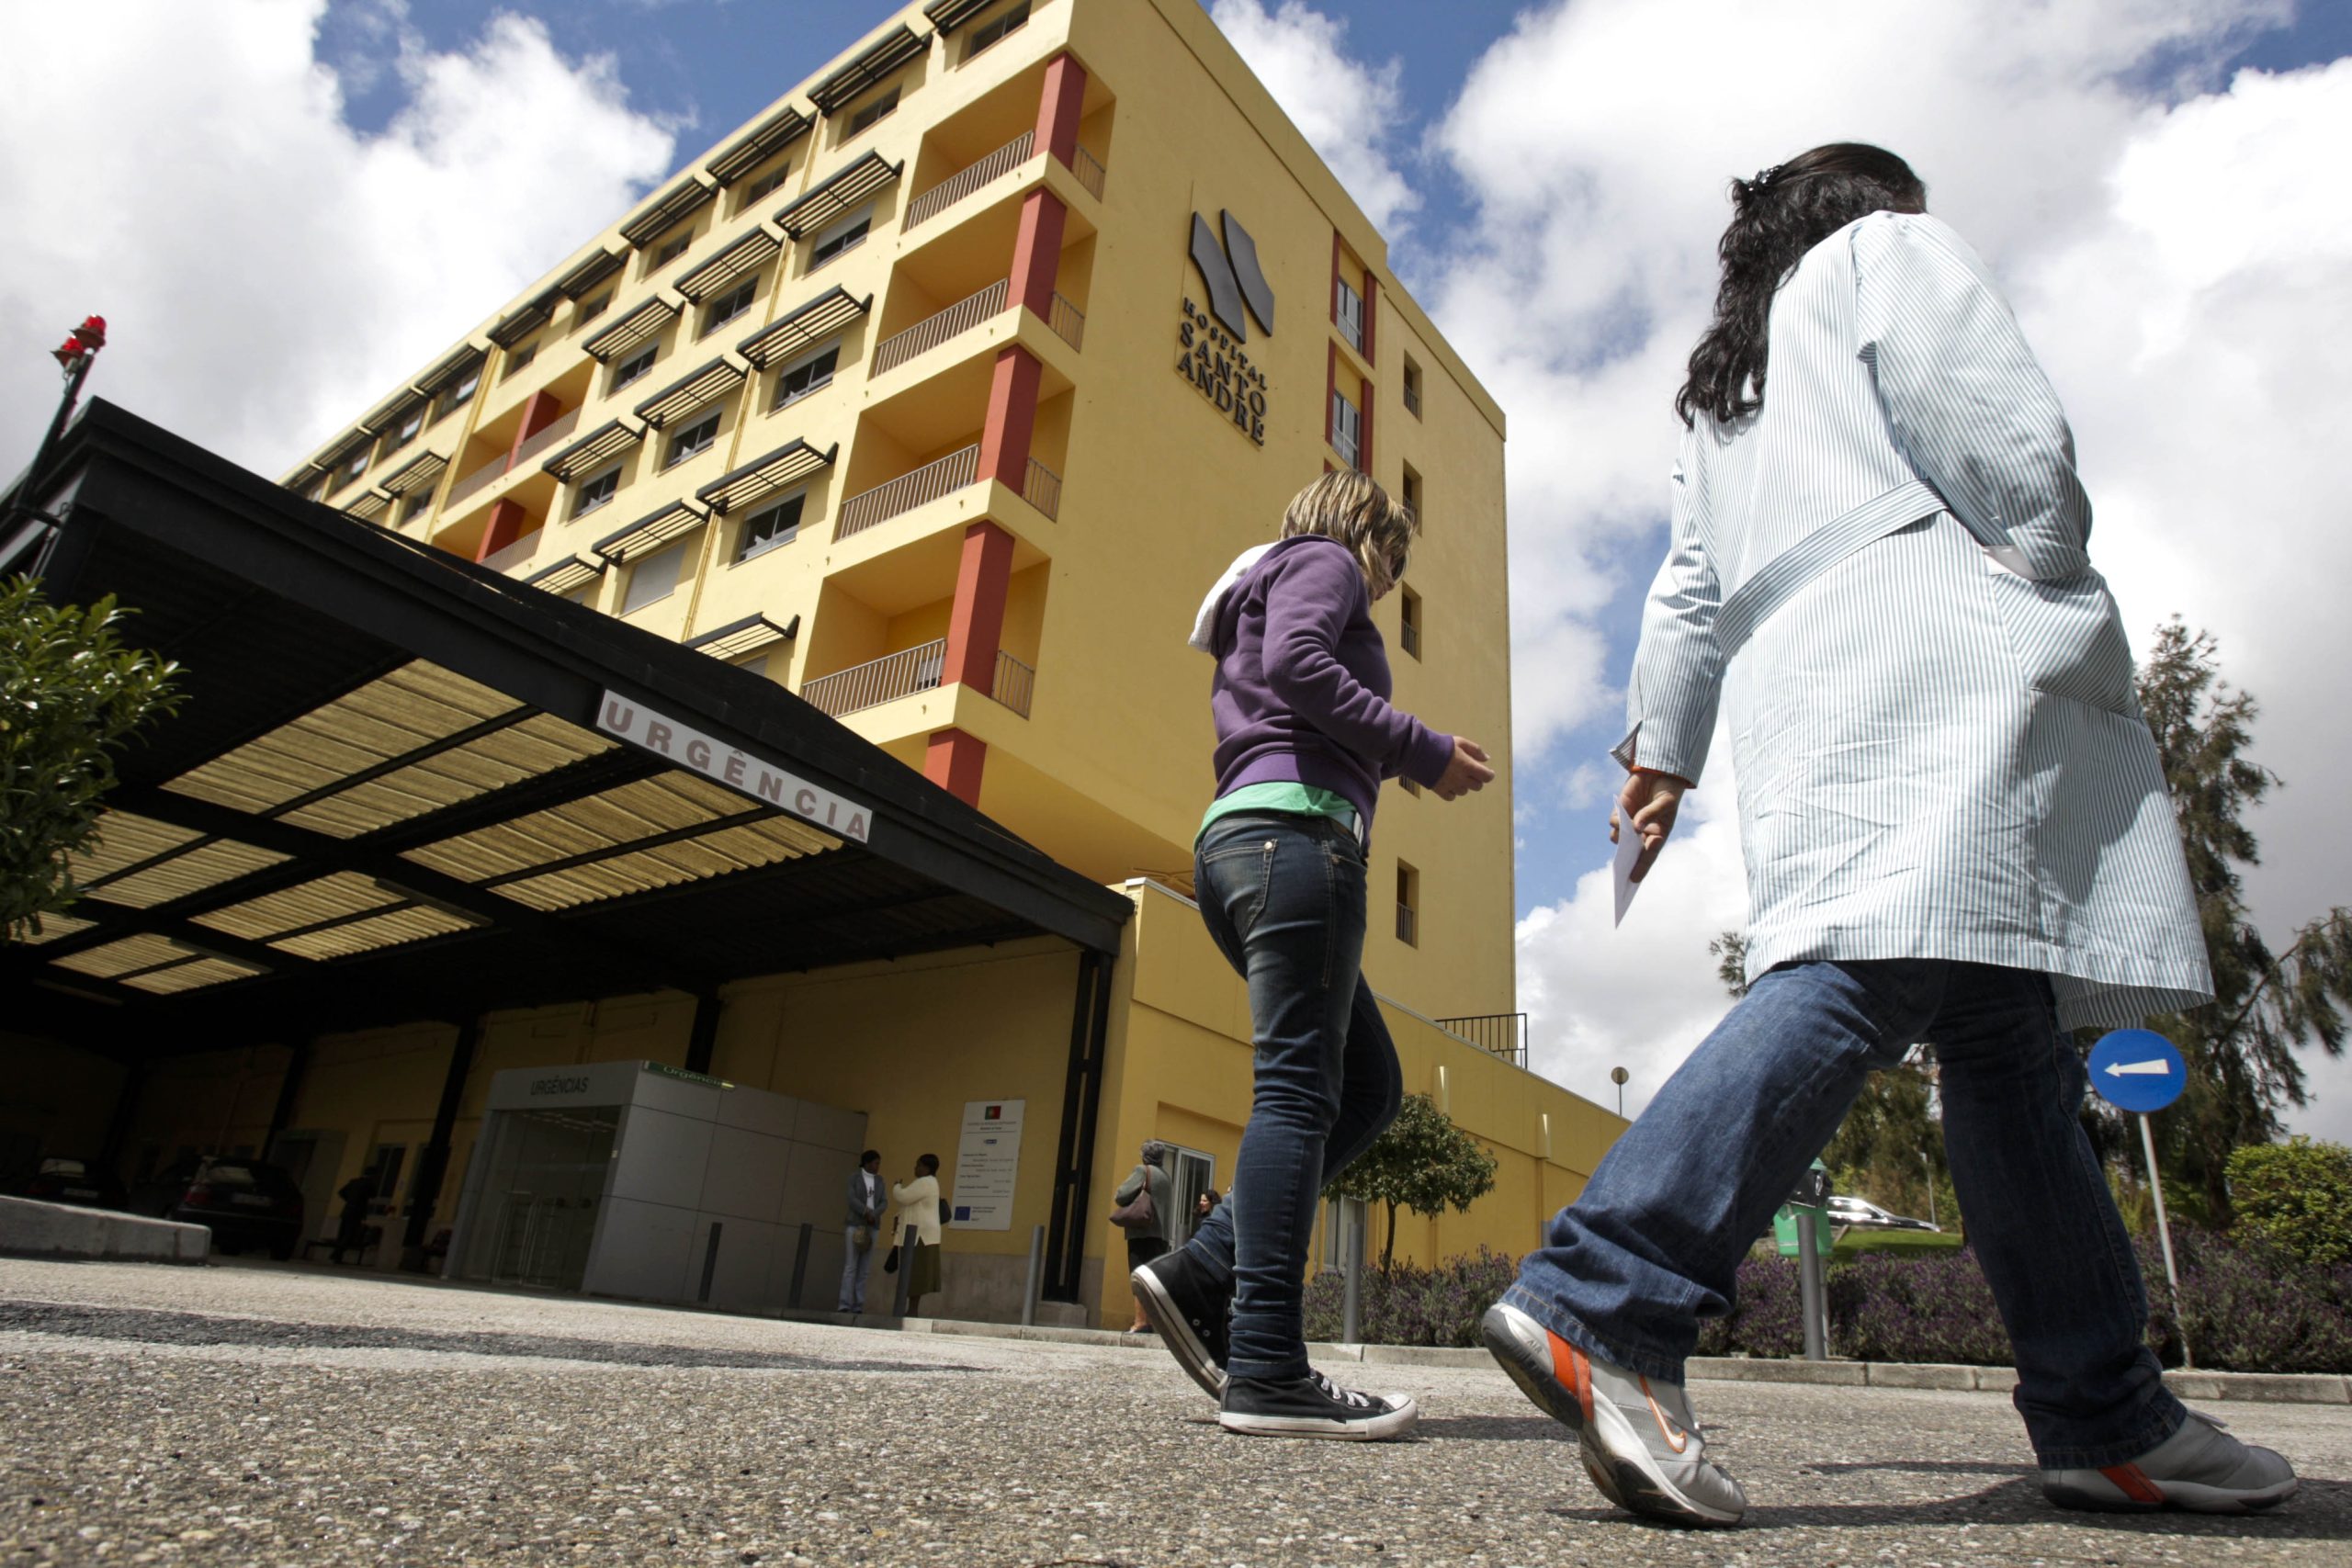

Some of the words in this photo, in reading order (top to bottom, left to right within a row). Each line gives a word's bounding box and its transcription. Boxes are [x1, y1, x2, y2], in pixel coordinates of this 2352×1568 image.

[1180, 321, 1267, 417] SANTO
[1183, 297, 1267, 390] HOSPITAL
[605, 700, 866, 840] URGÊNCIA
